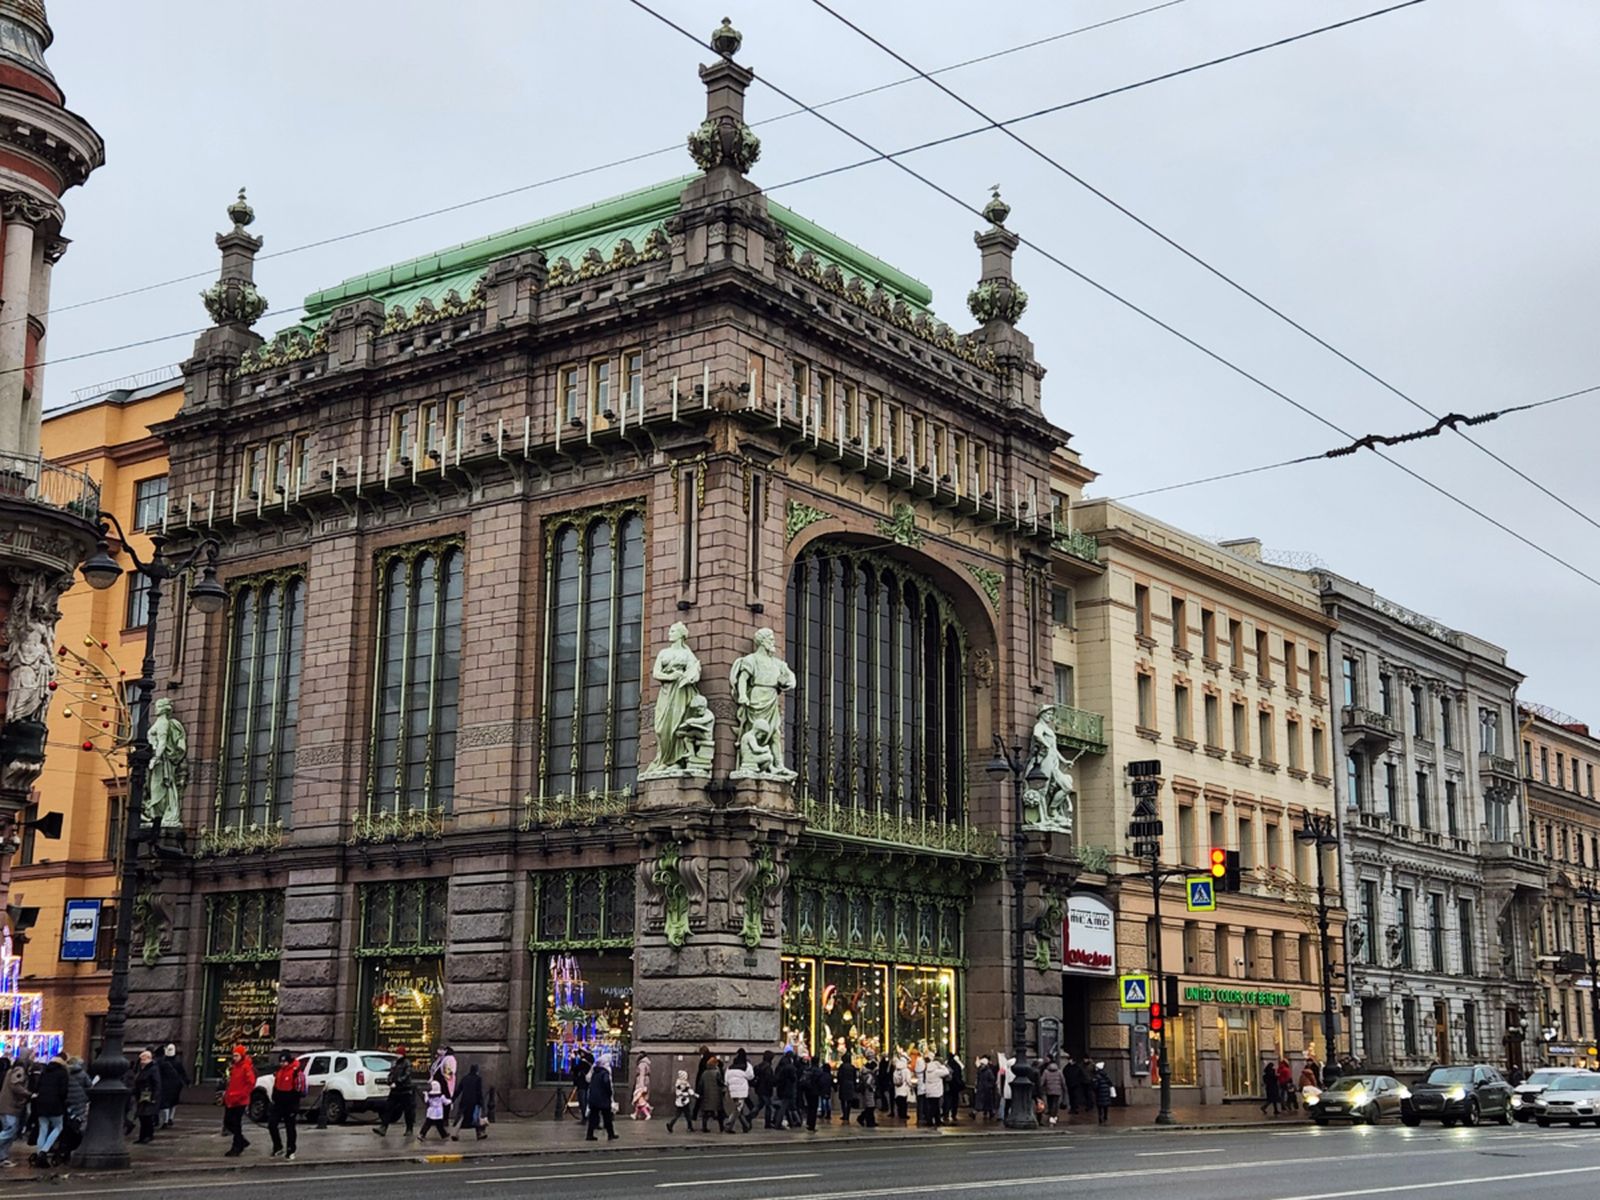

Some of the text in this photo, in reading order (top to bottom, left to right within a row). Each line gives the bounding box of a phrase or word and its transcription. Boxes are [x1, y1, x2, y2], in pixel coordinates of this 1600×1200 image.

[1185, 987, 1292, 1006] UNITED COLORS OF BENETTON
